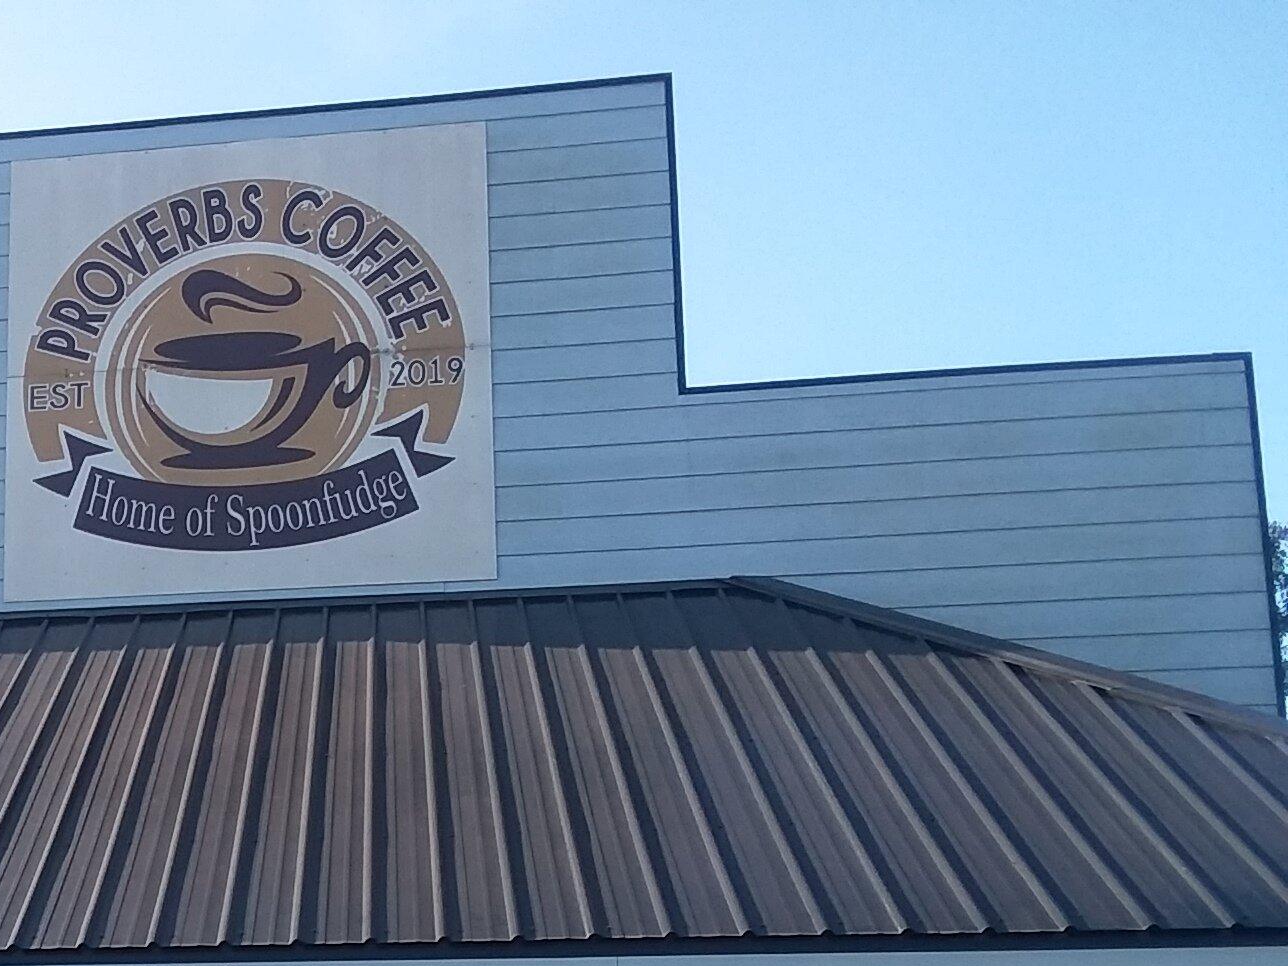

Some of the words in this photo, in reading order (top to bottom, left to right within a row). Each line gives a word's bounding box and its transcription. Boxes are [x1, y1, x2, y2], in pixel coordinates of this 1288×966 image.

[37, 183, 264, 361] PROVERBS
[281, 190, 451, 340] COFFEE
[28, 381, 90, 411] EST
[390, 357, 464, 387] 2019
[85, 473, 175, 536] Home
[185, 499, 217, 537] of
[226, 467, 408, 546] Spoonfudge
